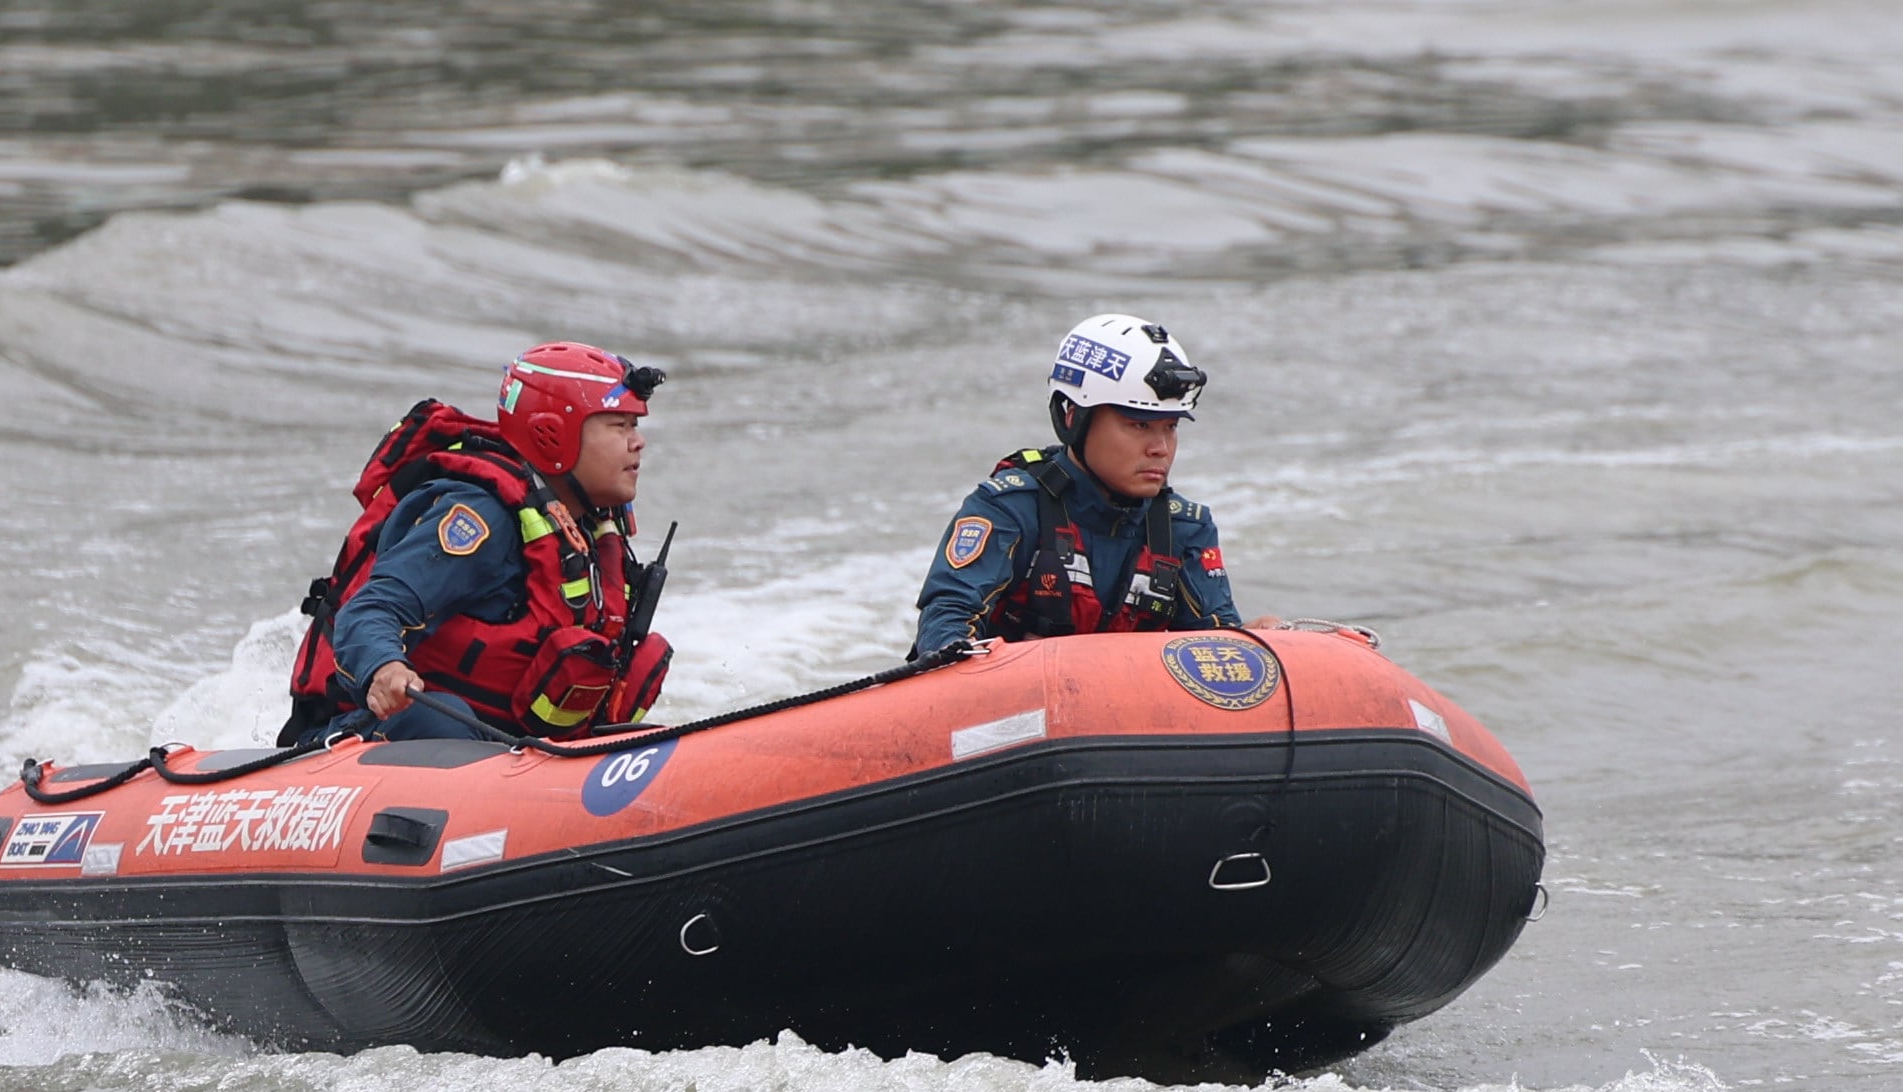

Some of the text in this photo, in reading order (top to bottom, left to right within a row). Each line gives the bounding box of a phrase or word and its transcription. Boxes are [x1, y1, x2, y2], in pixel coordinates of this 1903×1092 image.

[1188, 646, 1246, 662] 蓝天
[1198, 662, 1254, 682] 救援
[602, 748, 658, 787] 06
[136, 785, 362, 856] 天津蓝天救援队
[7, 842, 30, 856] BOAT
